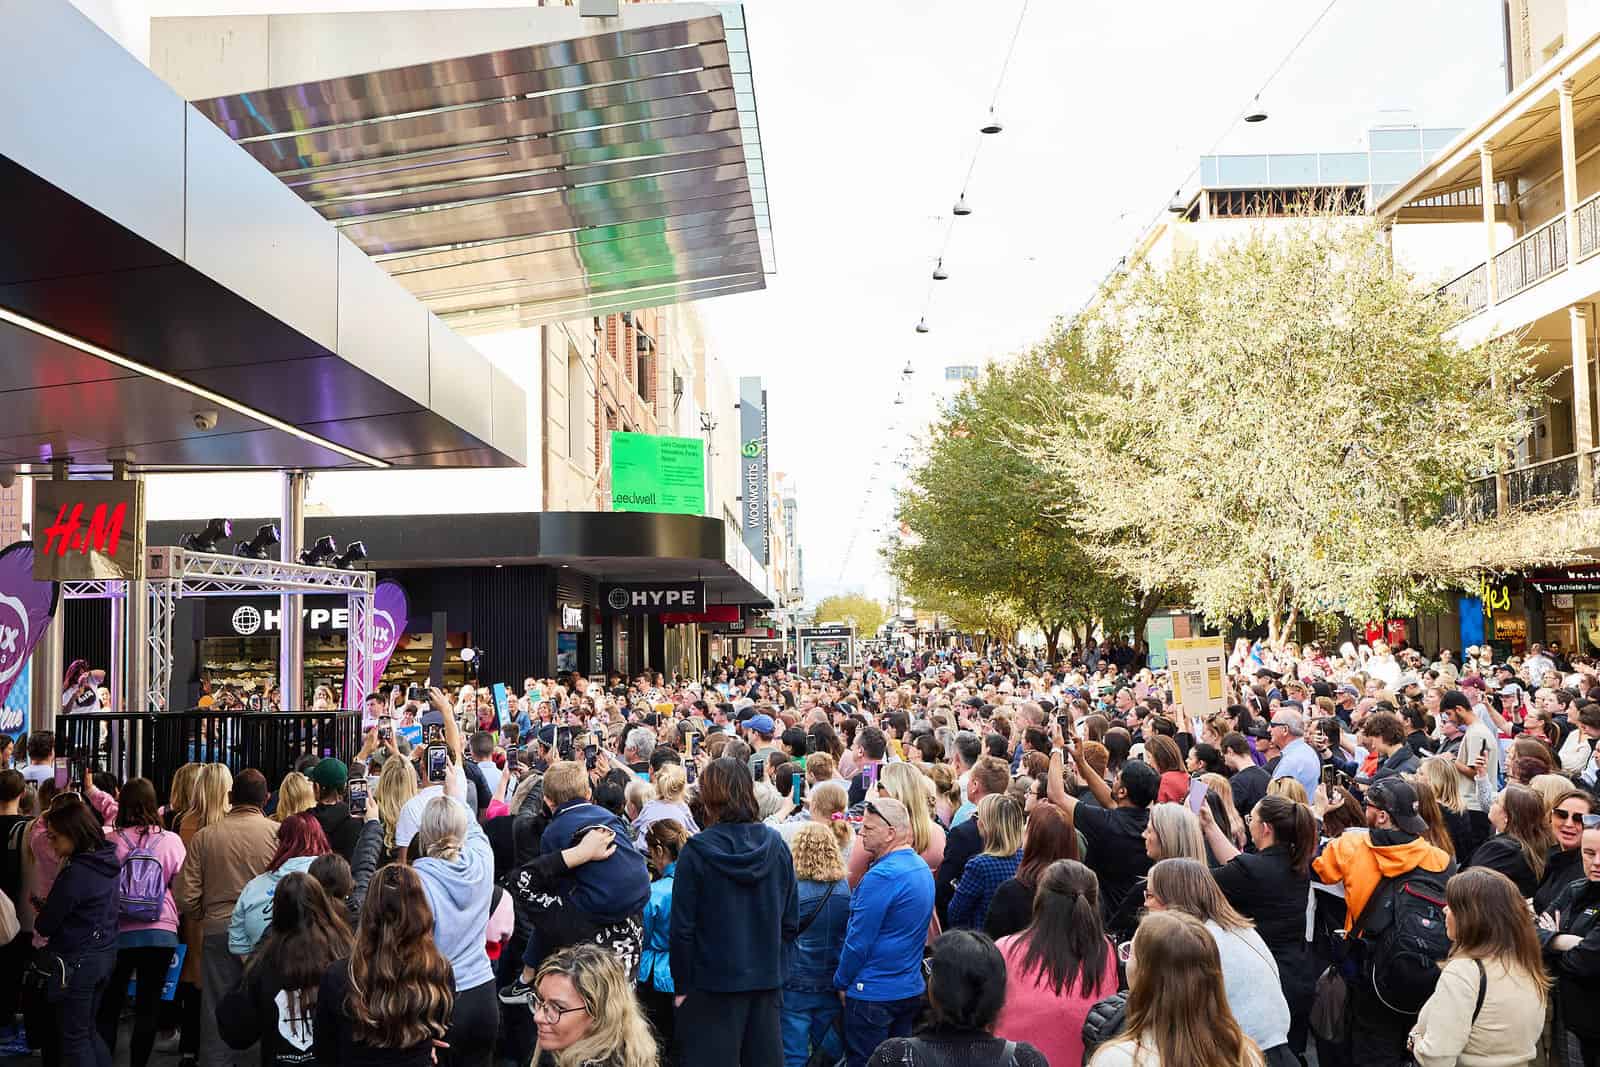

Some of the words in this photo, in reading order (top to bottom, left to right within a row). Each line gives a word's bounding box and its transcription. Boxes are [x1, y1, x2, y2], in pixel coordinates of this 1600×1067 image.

[748, 463, 759, 528] Woolworths
[43, 502, 127, 557] H&M
[632, 590, 695, 606] HYPE
[264, 608, 348, 630] HPE
